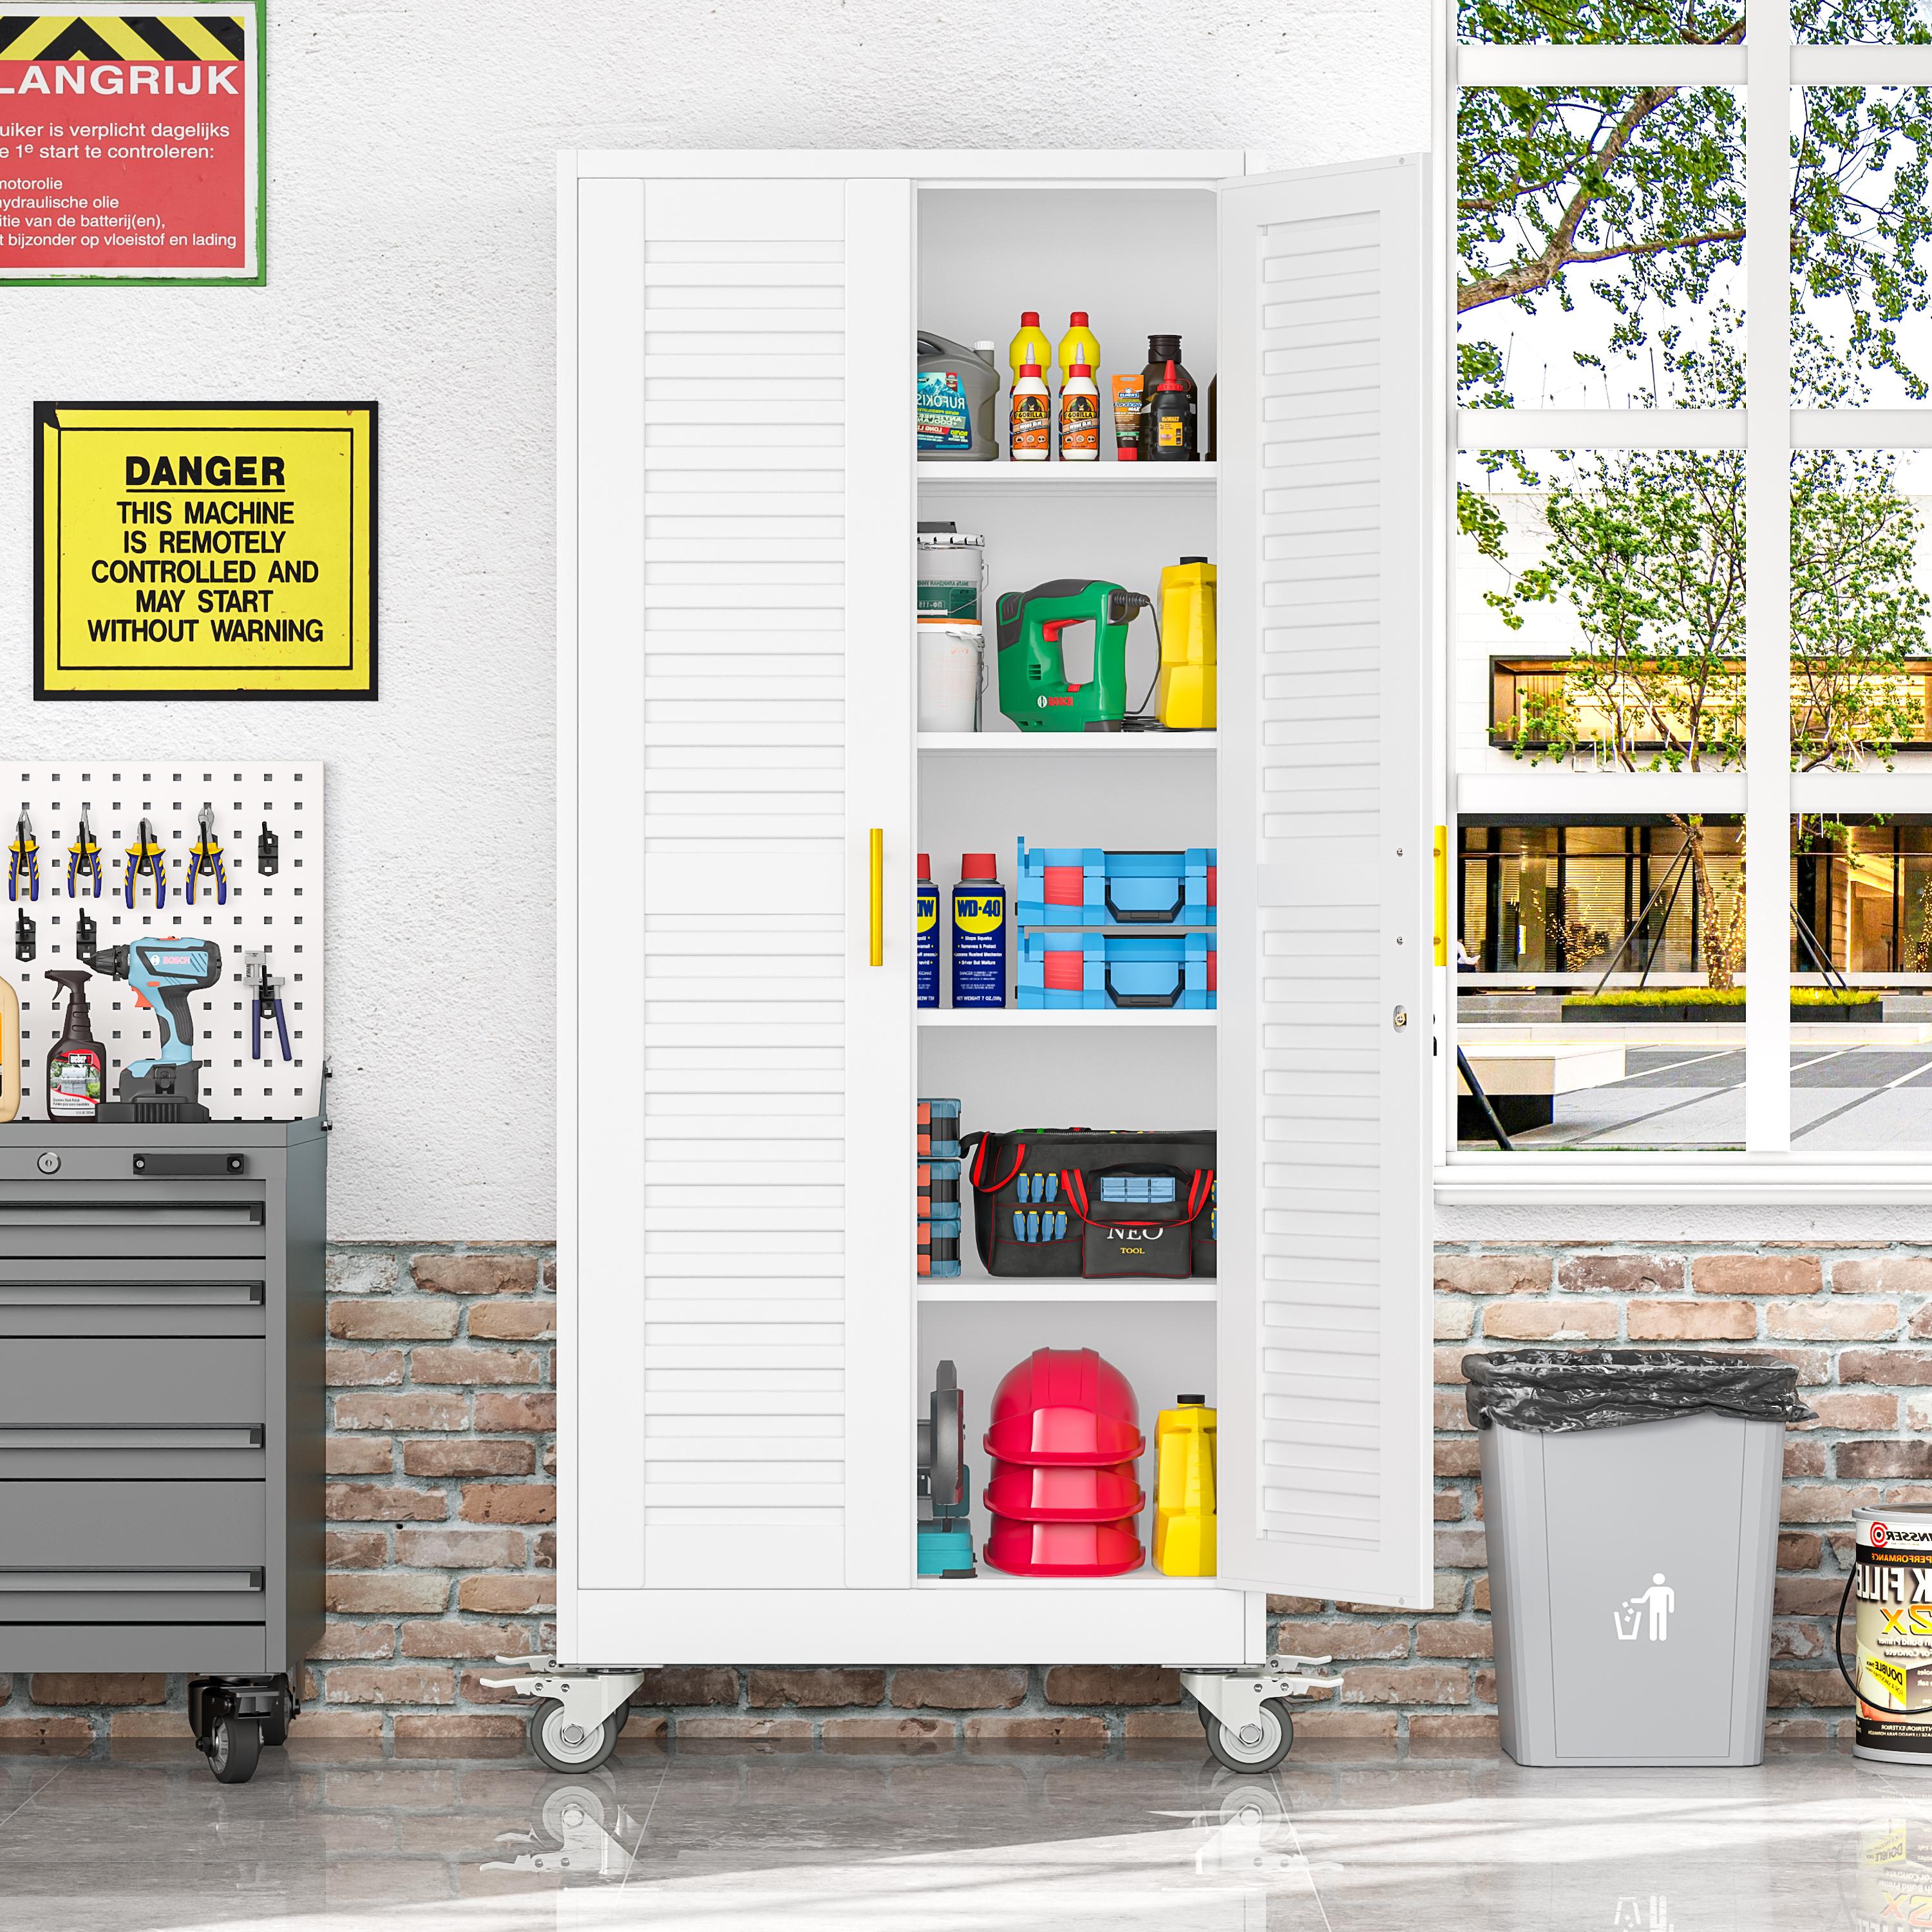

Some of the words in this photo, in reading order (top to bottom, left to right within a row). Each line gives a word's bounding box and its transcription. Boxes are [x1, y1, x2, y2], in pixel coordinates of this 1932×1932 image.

[0, 122, 44, 137] uiker
[50, 122, 64, 137] is
[70, 122, 146, 140] verplicht
[151, 122, 230, 141] dagelijks
[39, 145, 79, 158] start
[85, 145, 102, 158] te
[108, 144, 214, 159] controleren:
[93, 195, 119, 209] olie
[25, 217, 52, 227] van
[57, 214, 76, 227] de
[80, 214, 166, 231] batterij(en),
[8, 233, 77, 249] bijzonder
[81, 236, 100, 249] op
[103, 232, 166, 246] vloeistof
[169, 236, 187, 246] en
[193, 233, 236, 249] lading
[126, 456, 285, 486] DANGER
[117, 500, 172, 525] THIS
[185, 500, 294, 525] MACHINE
[124, 530, 147, 554] IS
[160, 530, 287, 554] REMOTELY
[91, 560, 256, 583] CONTROLLED
[268, 560, 319, 583] AND
[136, 589, 185, 612] MAY
[198, 589, 274, 613] START
[88, 619, 200, 643] WITHOUT
[211, 618, 323, 643] WARNING
[1048, 697, 1074, 706] BOSCH
[957, 900, 1001, 918] WD-40
[1107, 1227, 1164, 1240] NEO
